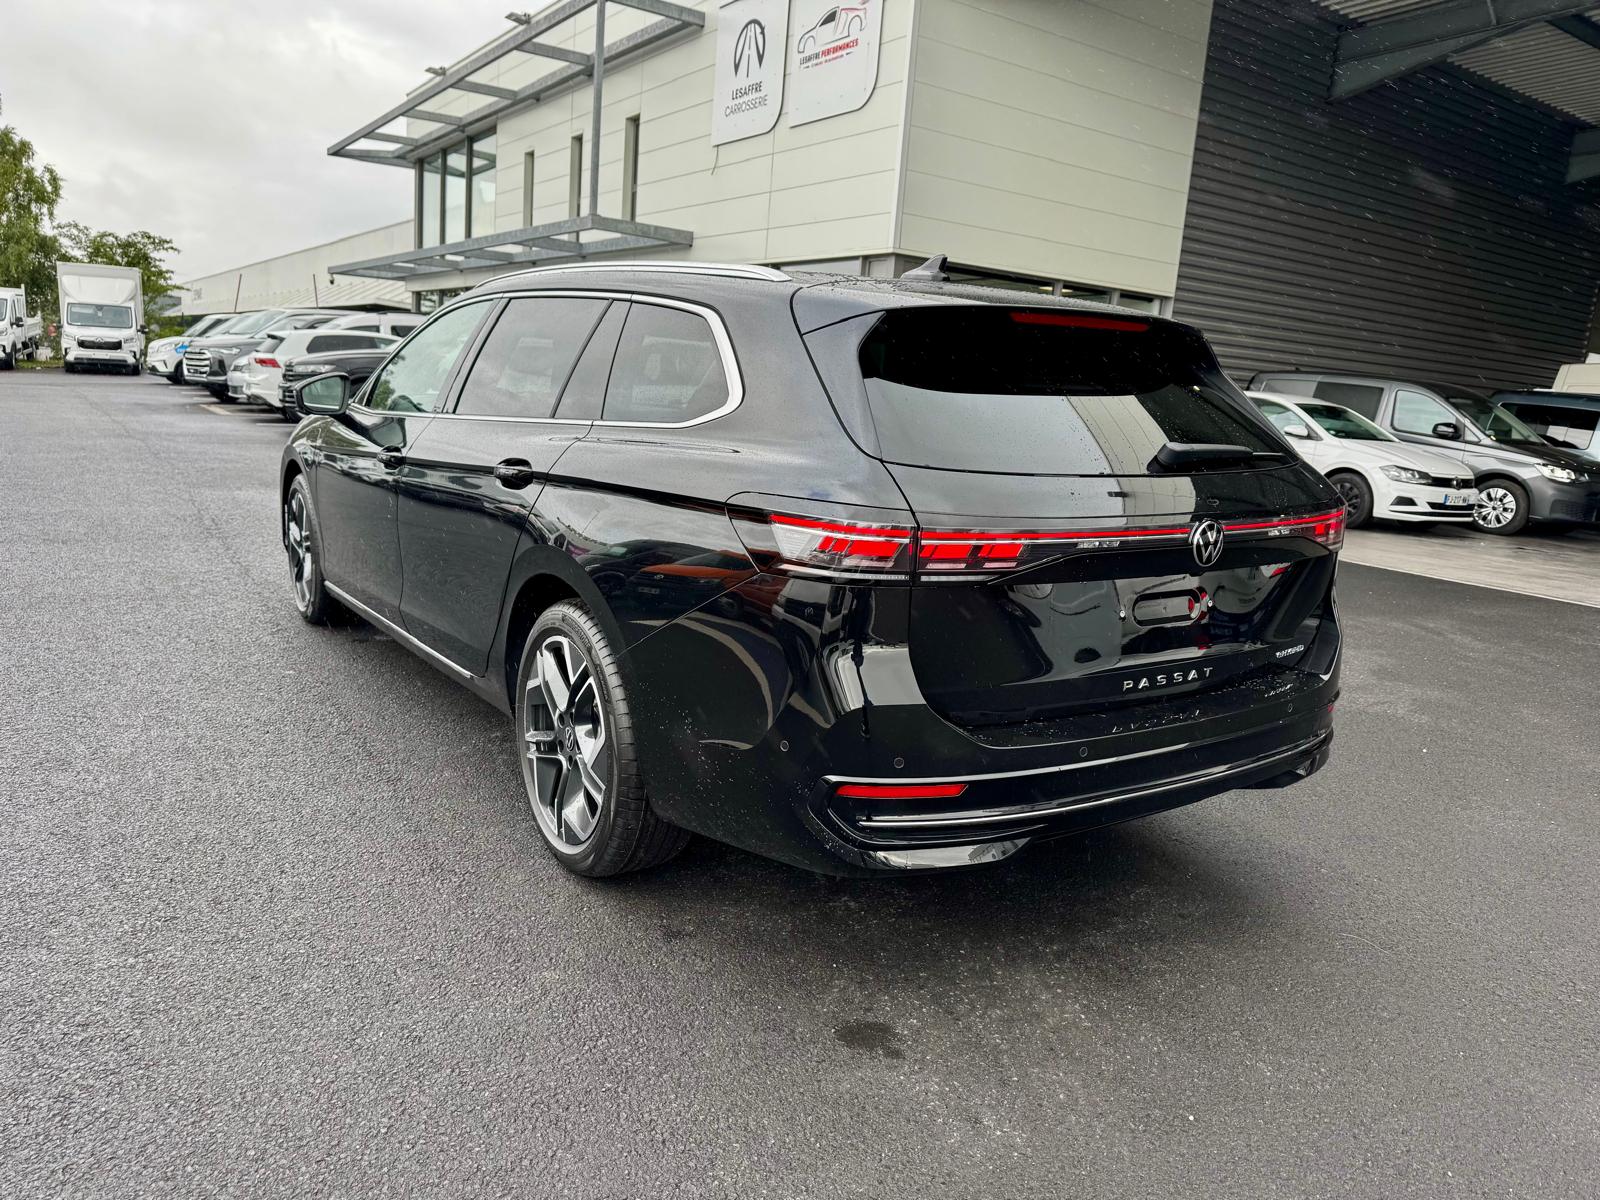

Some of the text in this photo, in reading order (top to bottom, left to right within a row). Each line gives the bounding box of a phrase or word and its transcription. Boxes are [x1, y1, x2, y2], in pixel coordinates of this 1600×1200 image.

[799, 51, 821, 66] LESAFFRE
[820, 38, 859, 57] PERFORMANCES
[731, 80, 762, 101] LESAFFRE
[724, 94, 768, 118] CARROSSERIE
[1122, 667, 1214, 692] PASSAT
